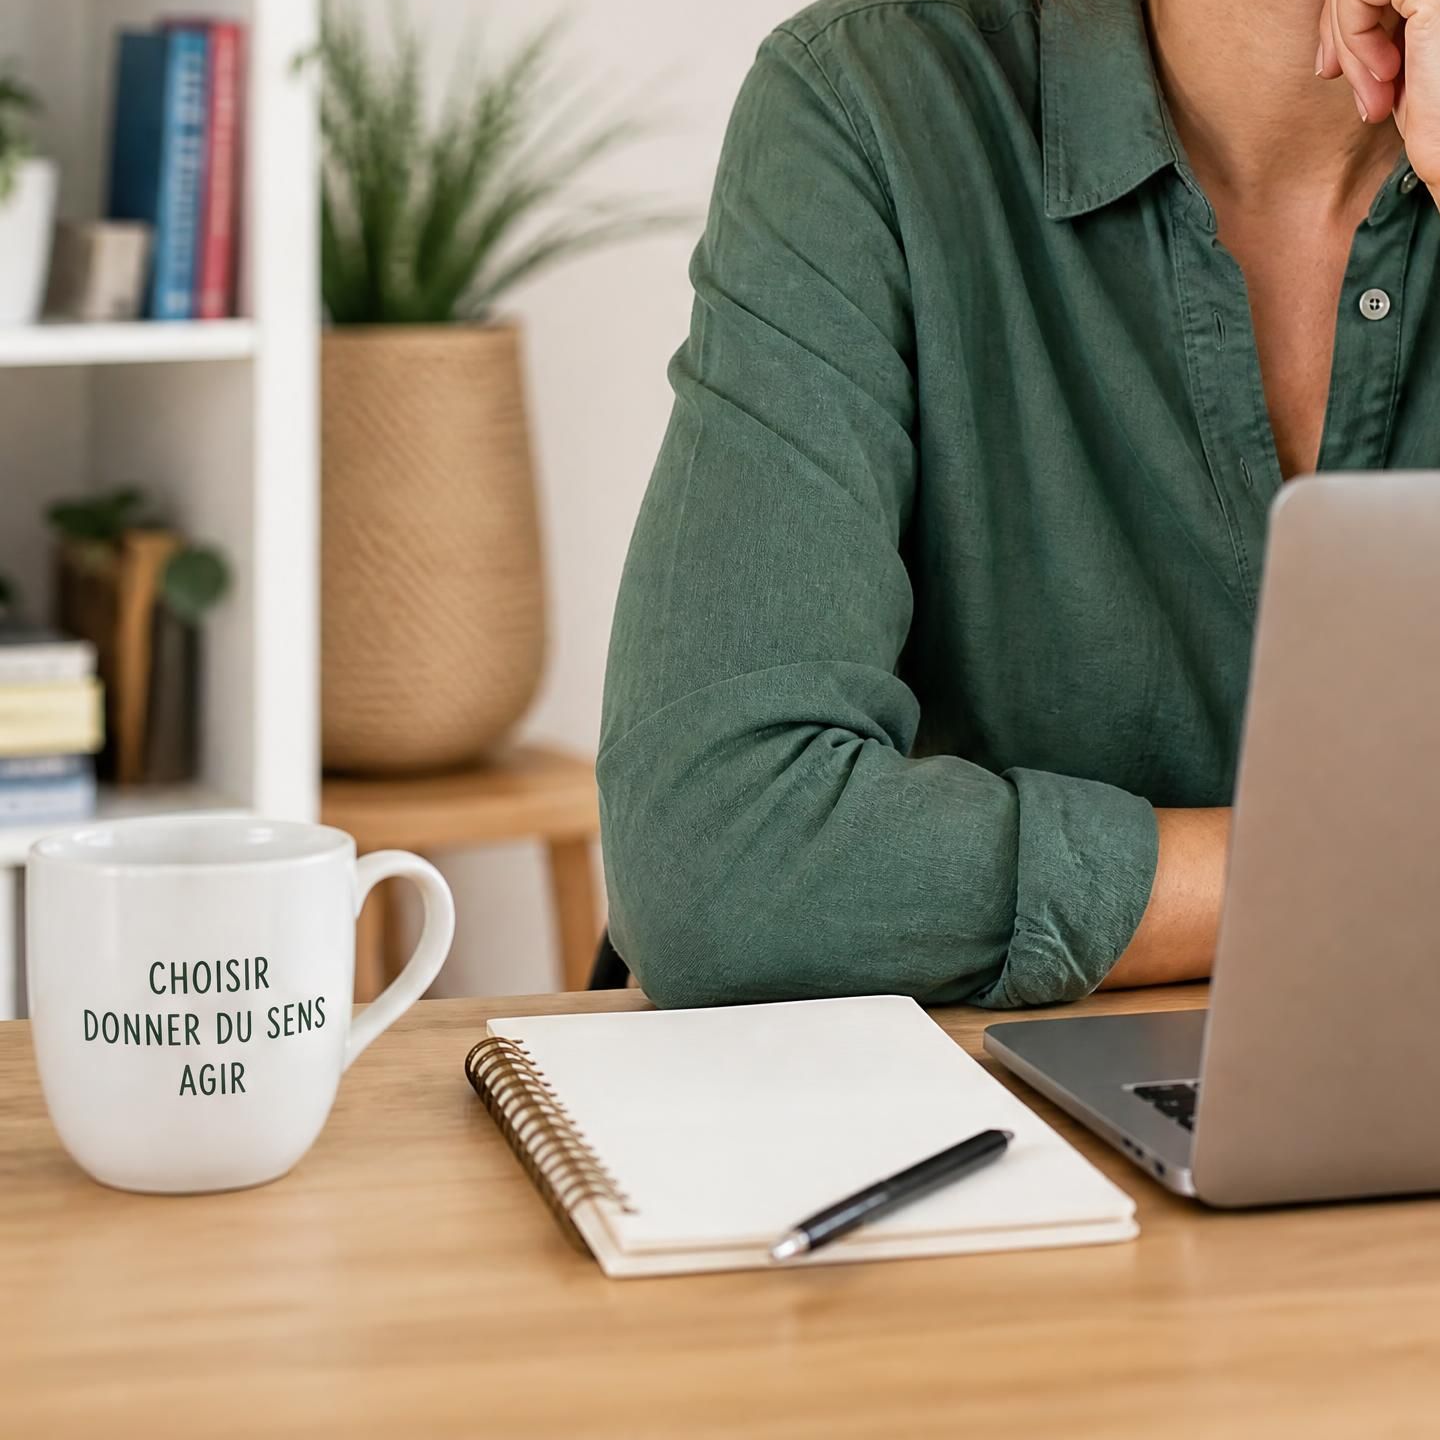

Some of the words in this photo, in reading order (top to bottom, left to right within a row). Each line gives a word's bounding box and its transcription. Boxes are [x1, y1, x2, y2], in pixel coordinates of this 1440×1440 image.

[149, 956, 270, 995] CHOISIR
[83, 1009, 201, 1046] DONNER
[216, 1010, 252, 1045] DU
[266, 996, 326, 1040] SENS
[178, 1061, 246, 1097] AGIR
